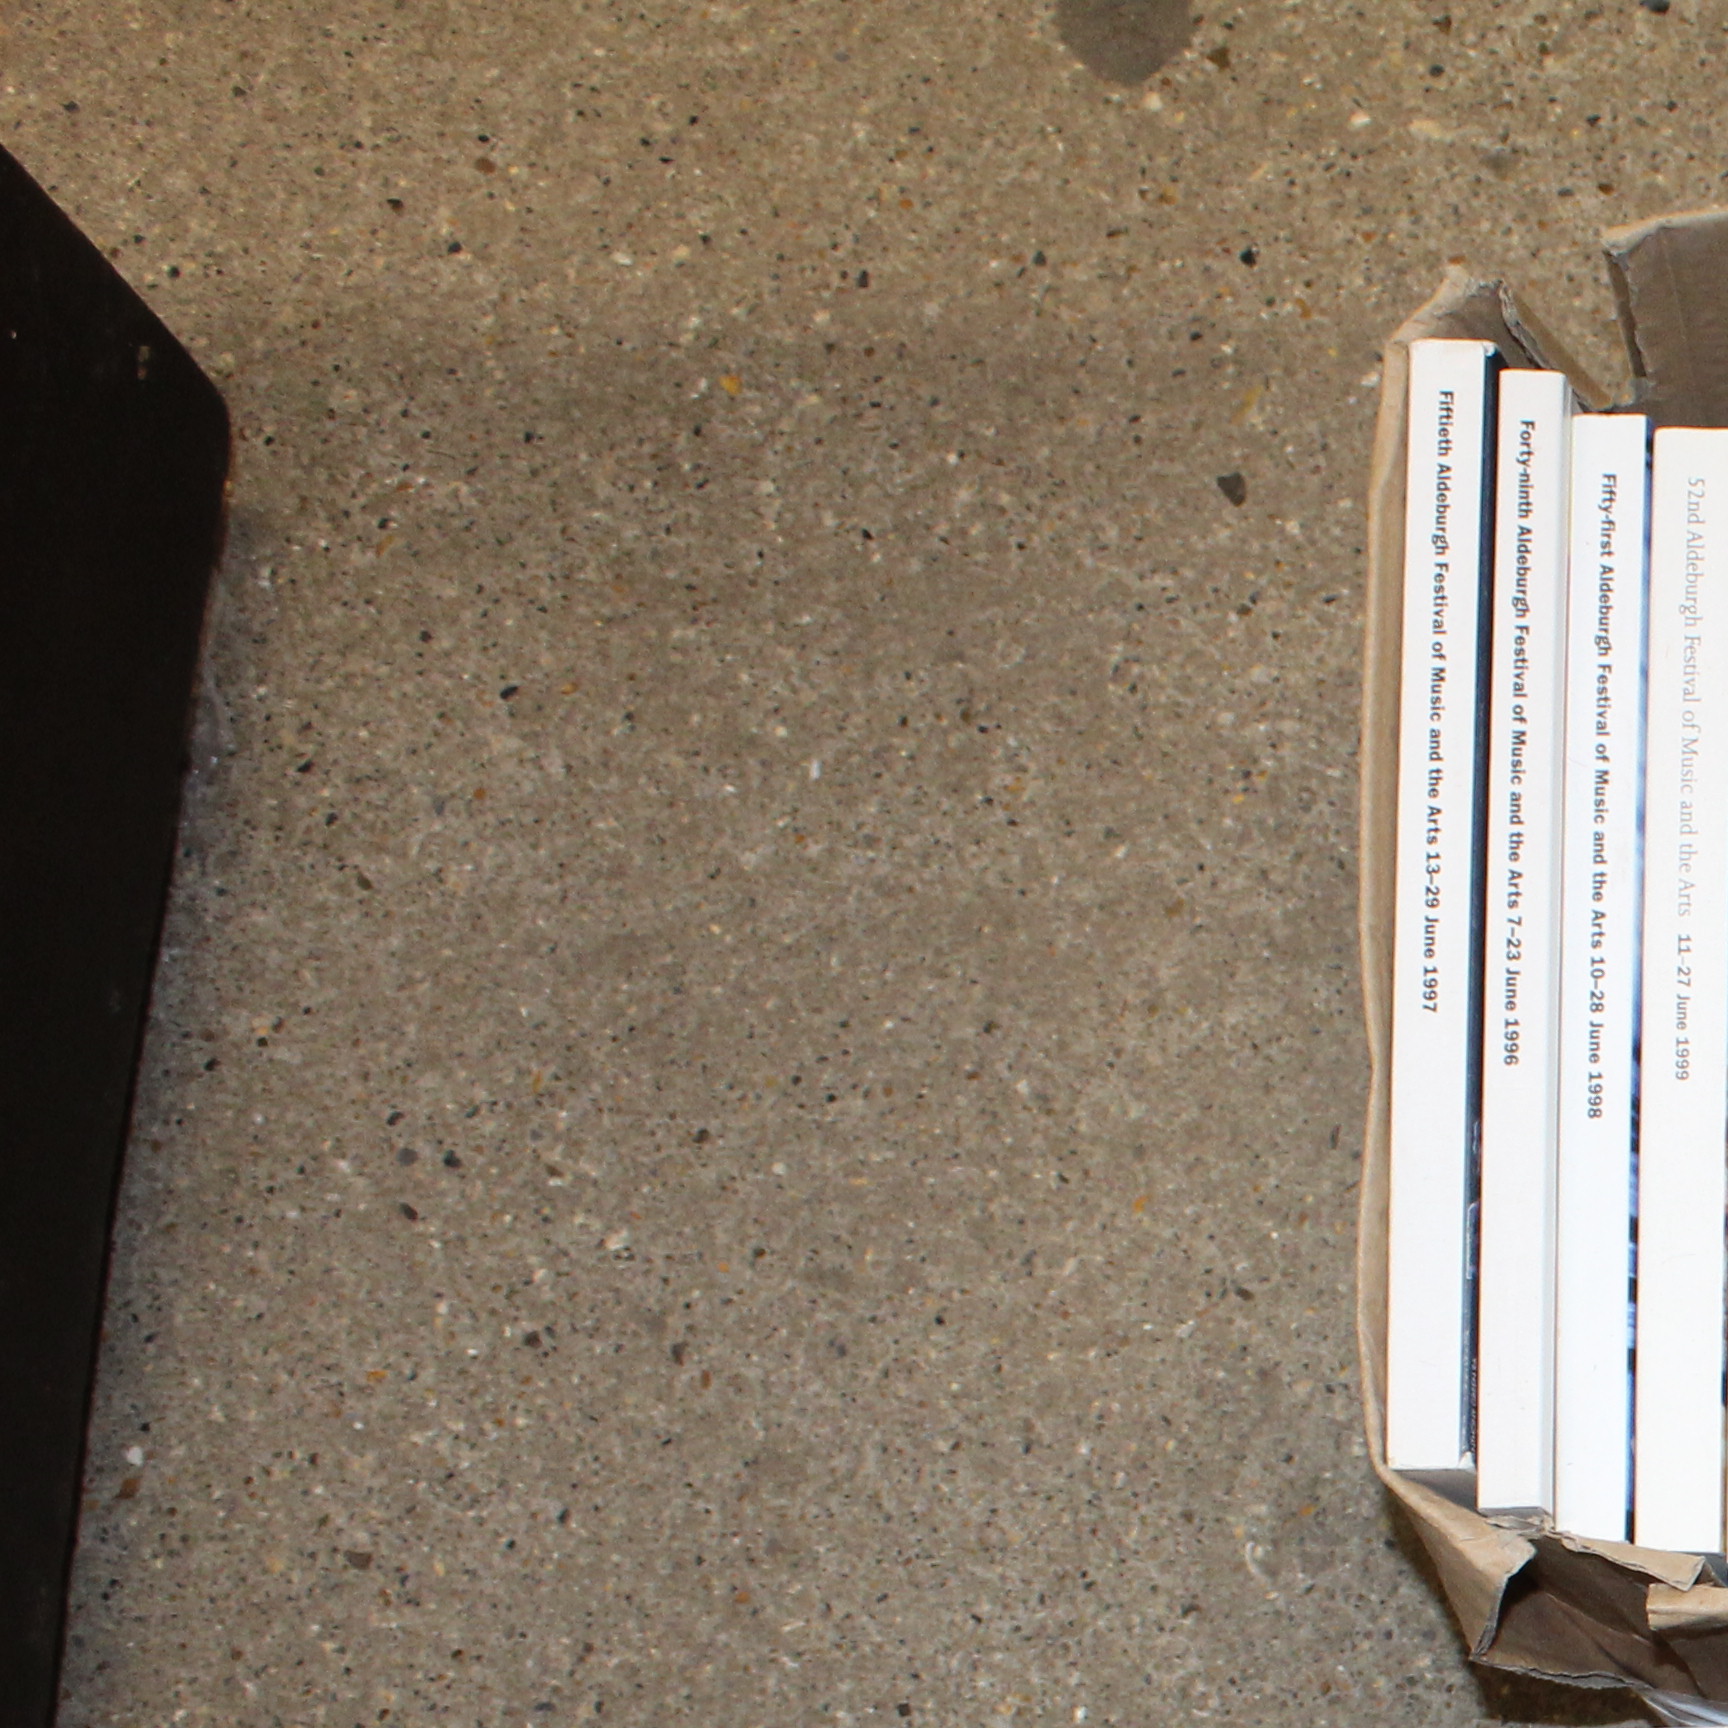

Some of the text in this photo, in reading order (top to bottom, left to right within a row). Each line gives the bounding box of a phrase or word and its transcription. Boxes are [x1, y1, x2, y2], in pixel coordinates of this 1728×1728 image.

[1422, 391, 1454, 1012] Fiftieth Aldeburgh Festival of Music and the Arts 13–29 June 1997
